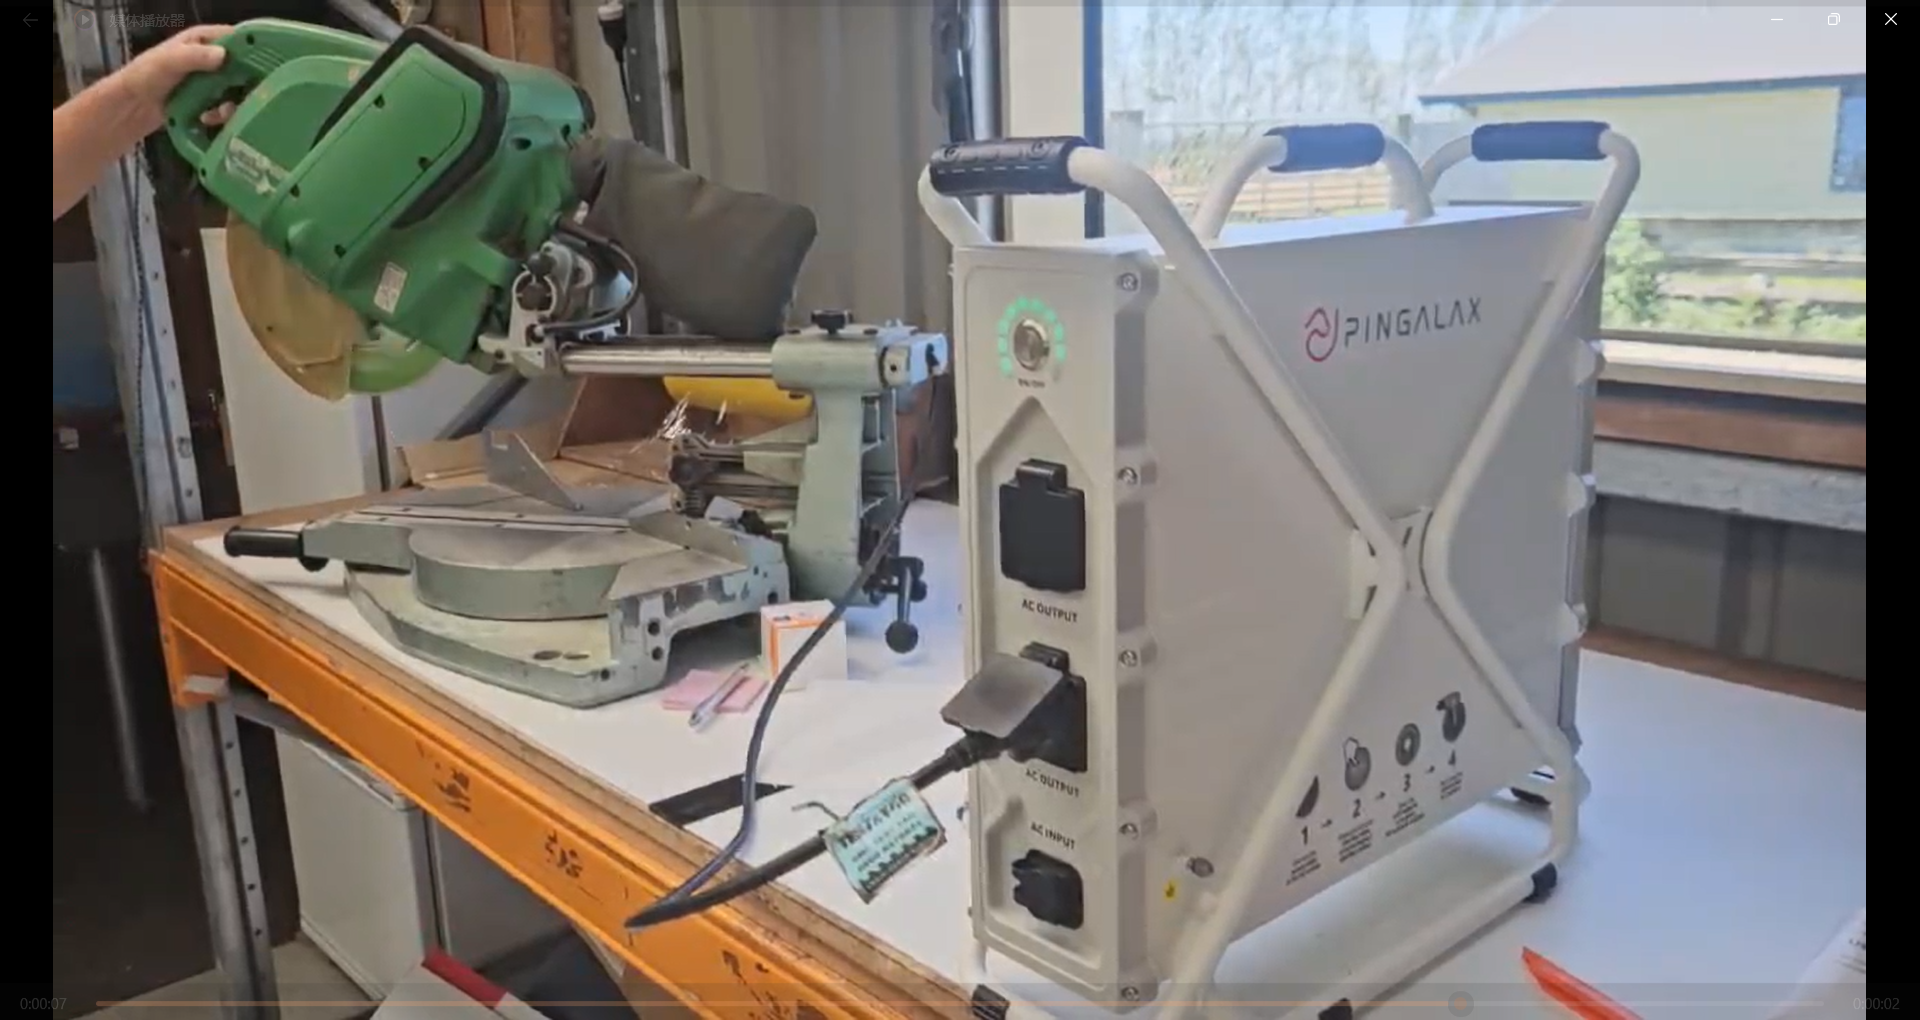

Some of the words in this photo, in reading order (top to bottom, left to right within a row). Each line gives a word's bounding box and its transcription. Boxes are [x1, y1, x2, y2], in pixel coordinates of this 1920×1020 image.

[1344, 297, 1482, 348] PINGALAX
[1021, 598, 1035, 612] AC
[1036, 602, 1078, 623] OUTPUT
[1039, 773, 1079, 798] OUTPUT
[1302, 826, 1308, 845] 1
[1353, 799, 1360, 818] 2
[1403, 773, 1411, 792] 3
[1044, 828, 1075, 850] INPUT
